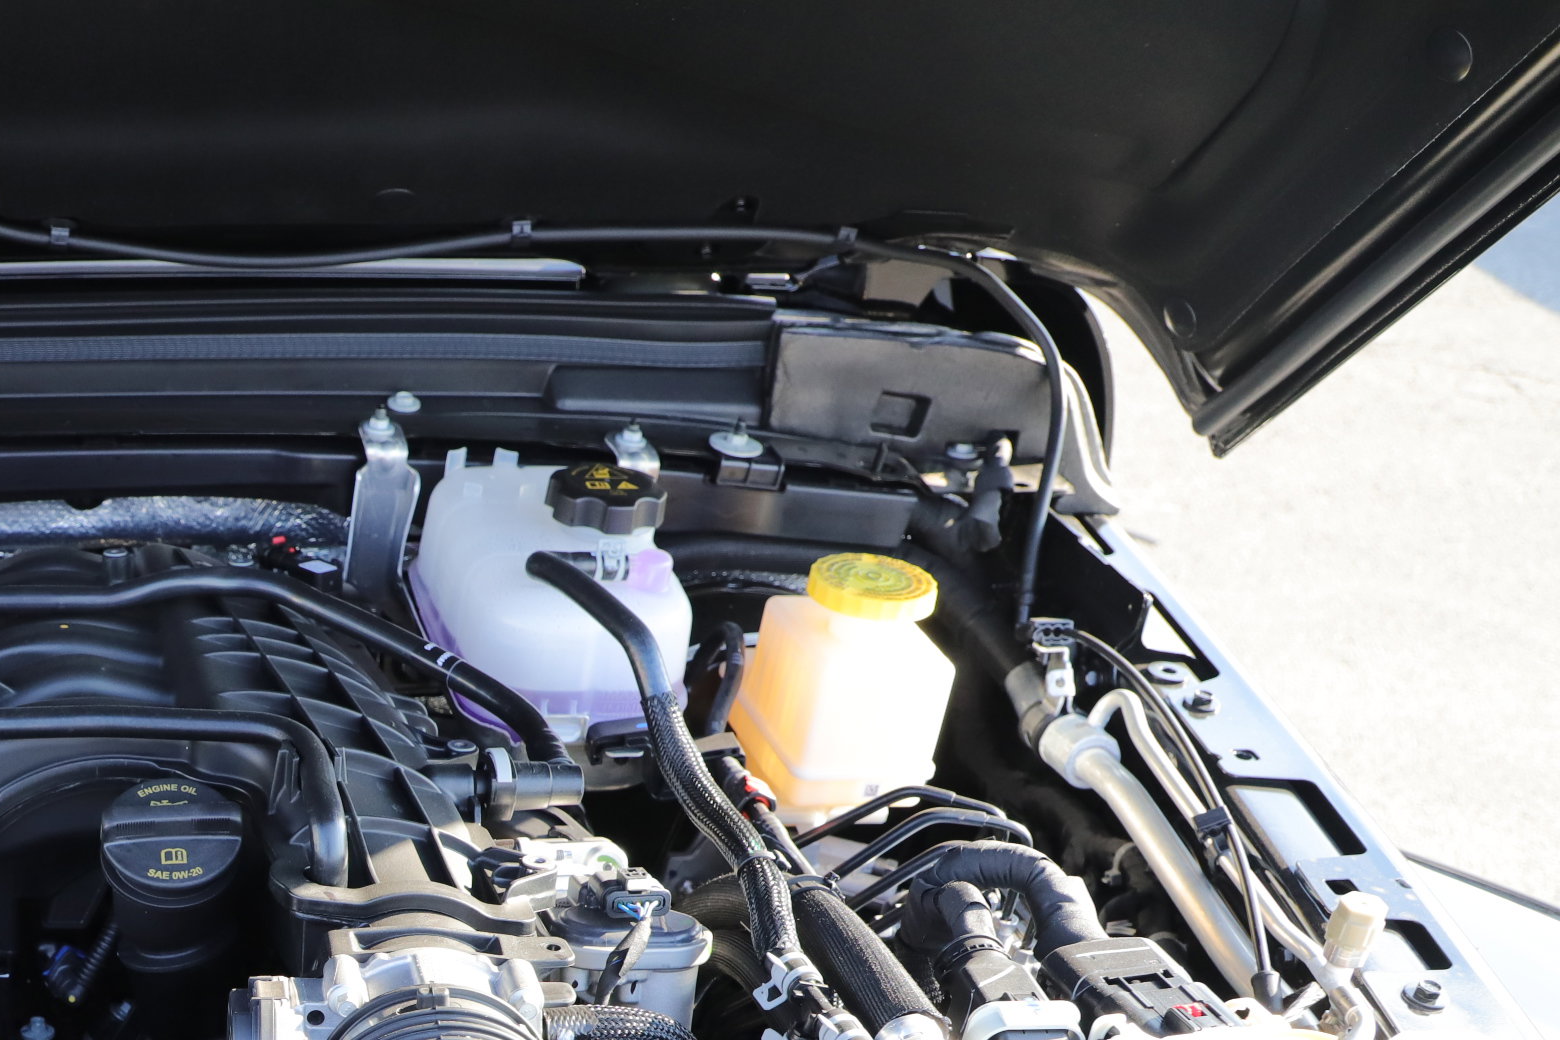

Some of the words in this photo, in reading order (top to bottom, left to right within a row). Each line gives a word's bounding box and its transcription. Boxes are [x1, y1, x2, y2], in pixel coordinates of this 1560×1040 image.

[136, 784, 178, 798] ENGINE
[180, 784, 198, 796] OIL
[147, 868, 170, 880] SAE
[172, 866, 204, 880] 0W-20
